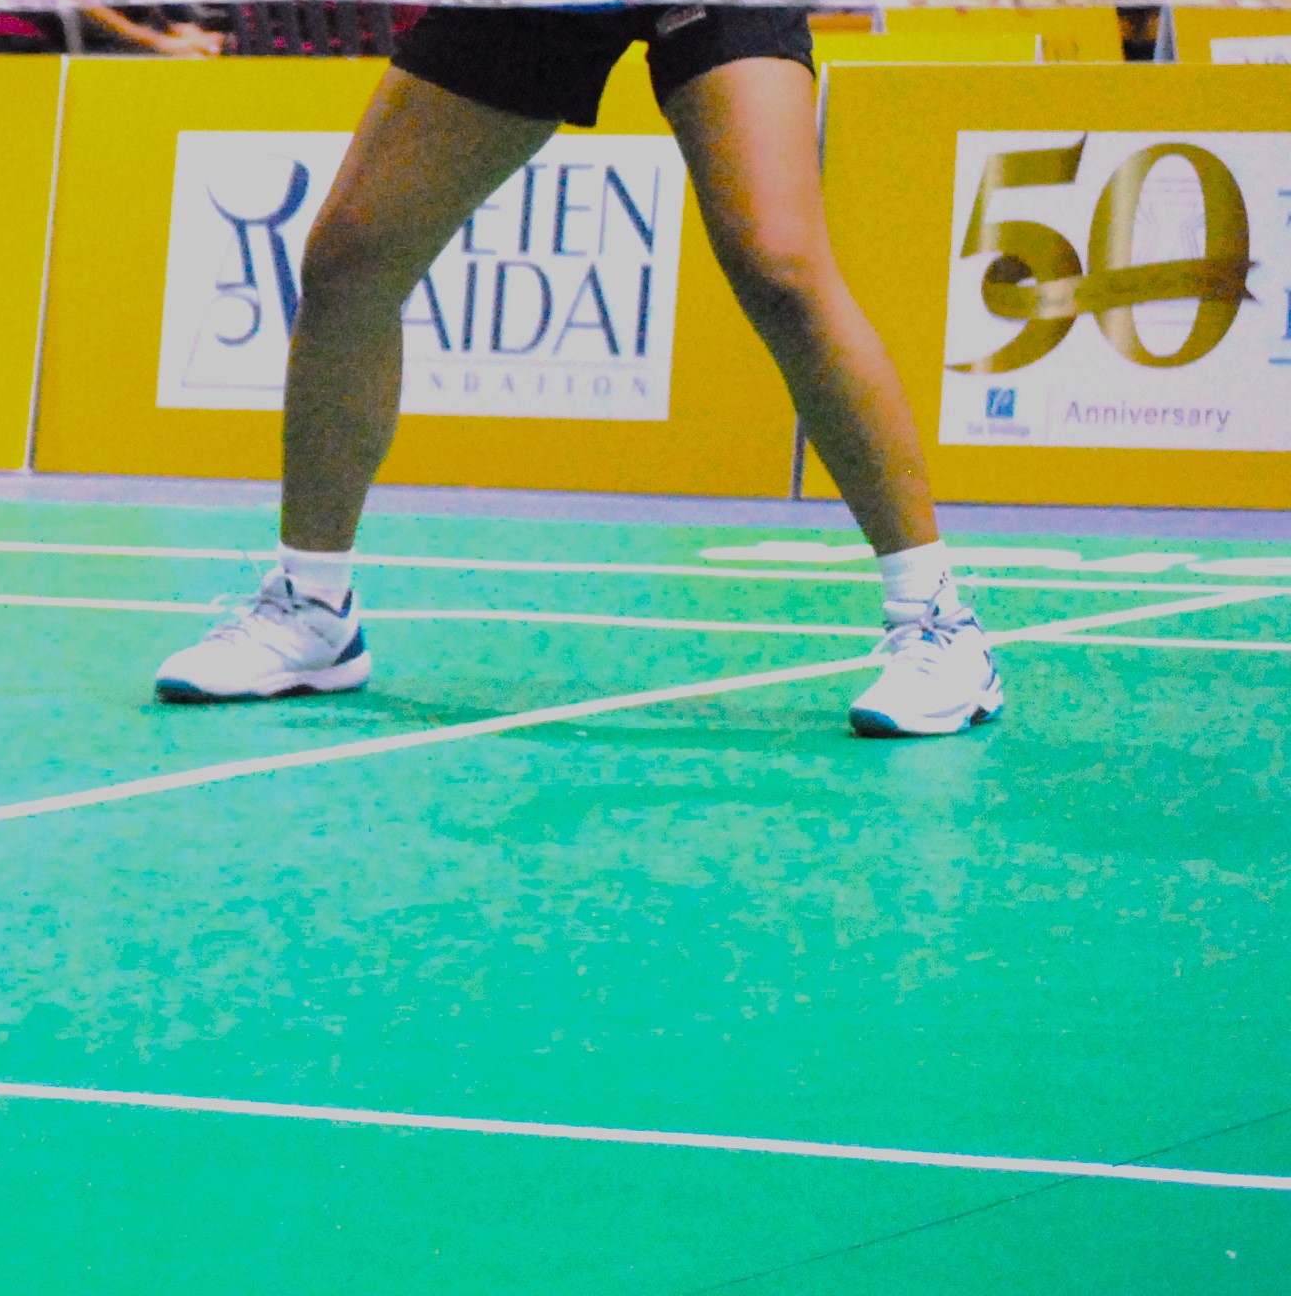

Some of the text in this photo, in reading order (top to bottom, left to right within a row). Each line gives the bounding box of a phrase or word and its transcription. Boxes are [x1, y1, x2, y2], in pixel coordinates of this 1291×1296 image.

[944, 131, 1257, 374] 50
[401, 260, 653, 357] AIDAI
[1064, 401, 1231, 433] Anniversary
